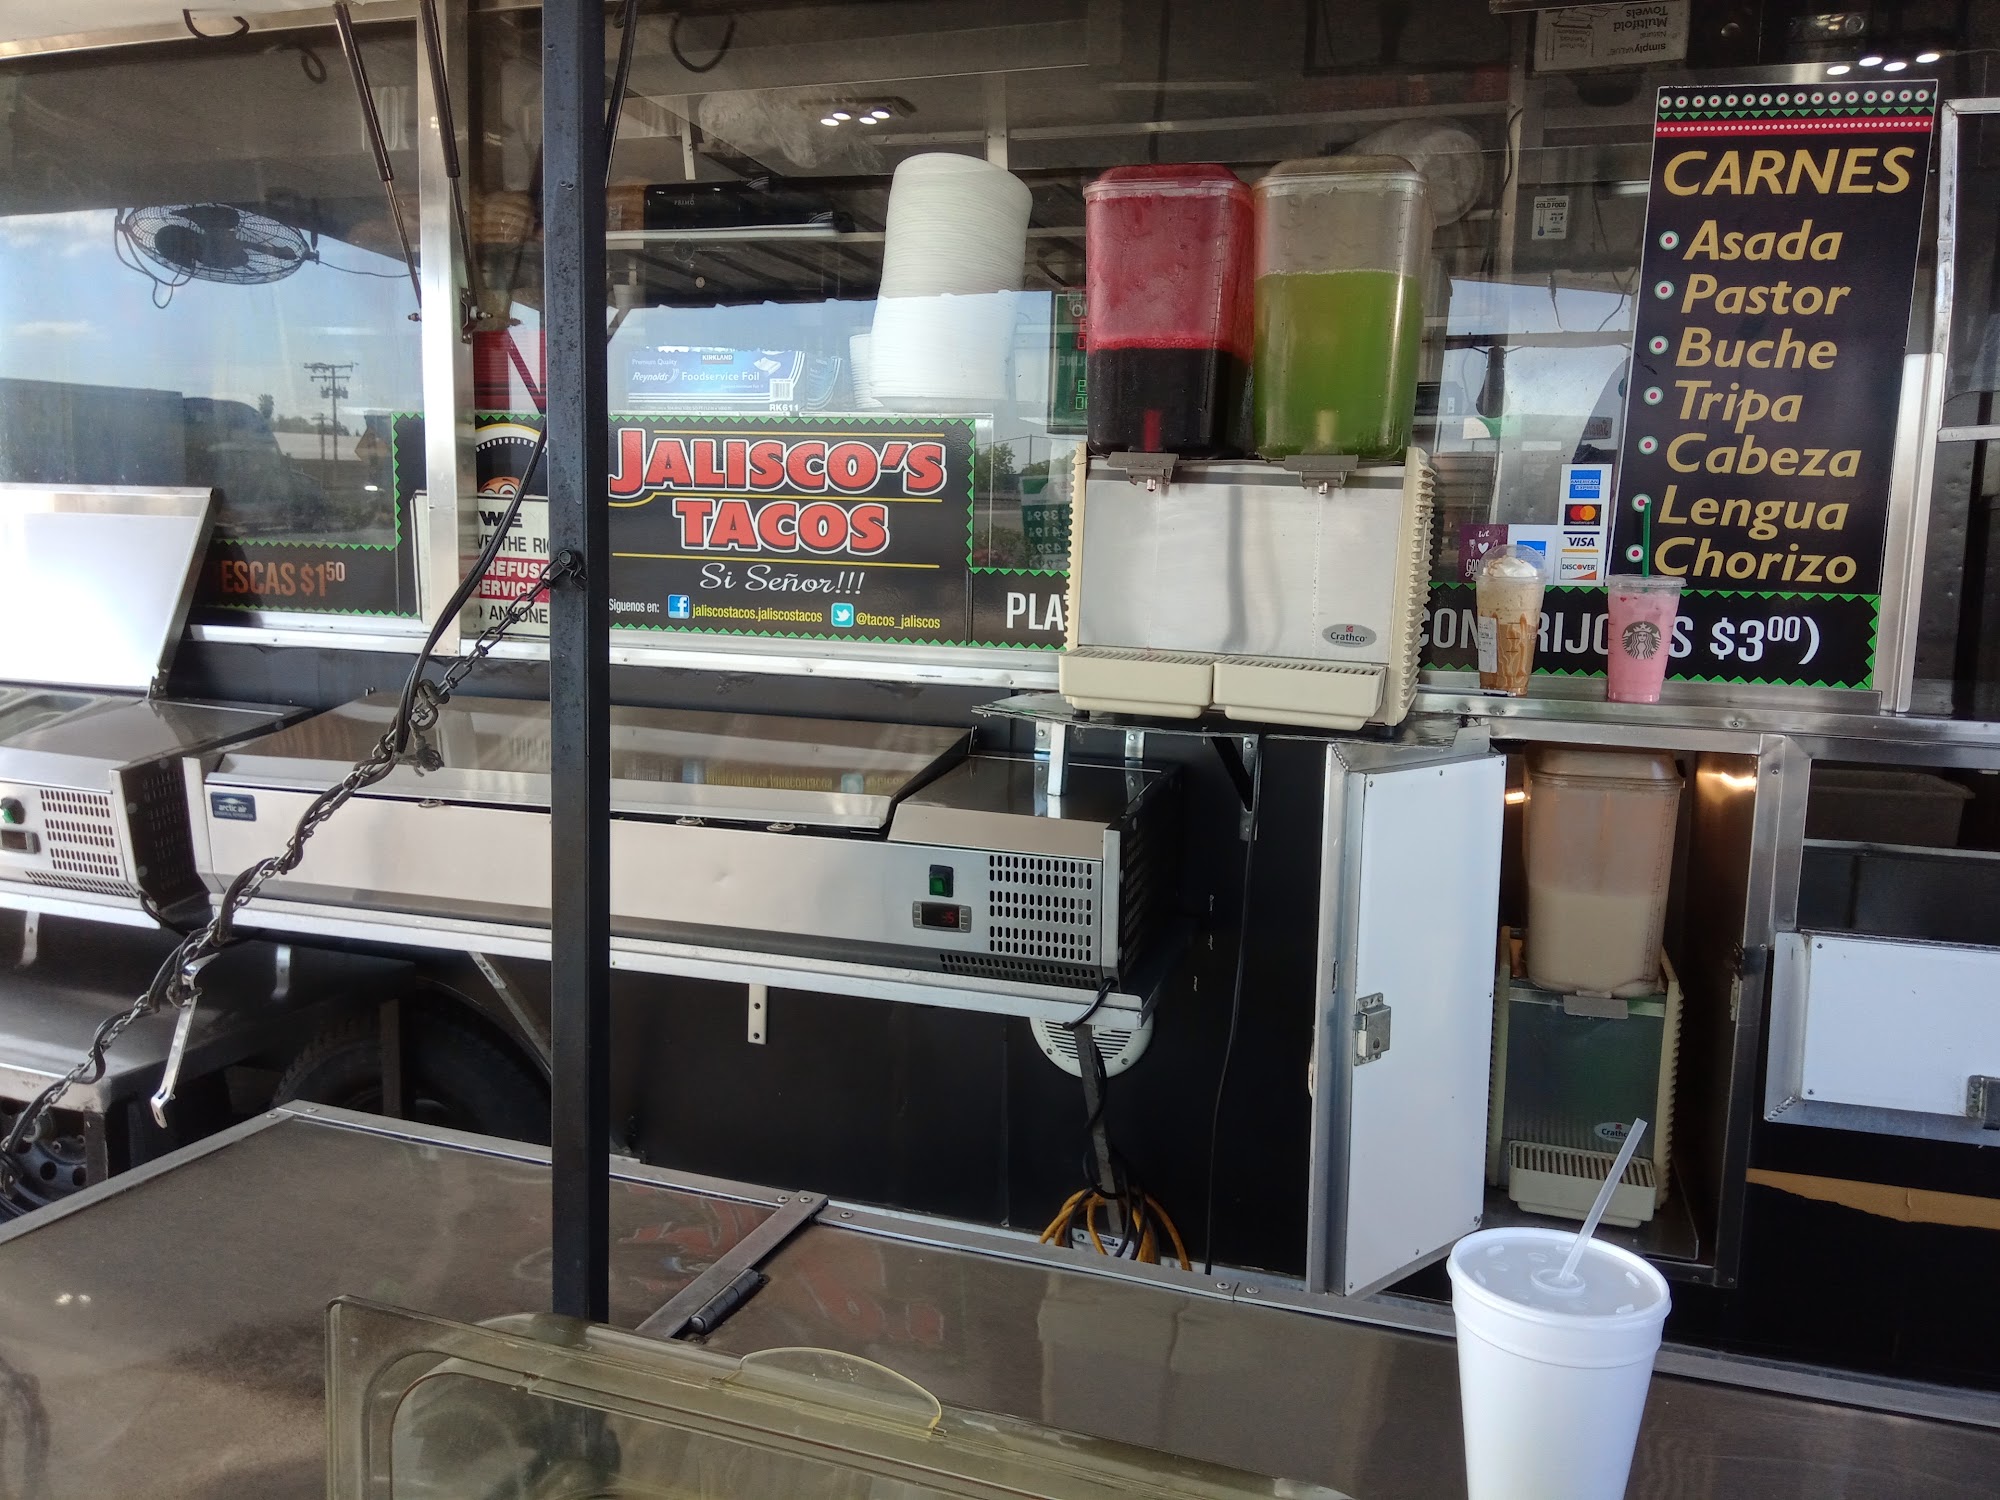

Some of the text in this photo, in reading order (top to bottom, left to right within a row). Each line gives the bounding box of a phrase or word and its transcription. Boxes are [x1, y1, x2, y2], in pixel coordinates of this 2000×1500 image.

[1626, 5, 1668, 17] Towels
[1613, 17, 1668, 33] Multifold
[1663, 146, 1915, 196] CARNES
[1682, 219, 1843, 261] Asada
[1681, 273, 1851, 315] Pastor
[1675, 326, 1838, 370] Buche
[657, 358, 677, 367] Quality
[632, 371, 760, 382] Reynolds Foodservice Foil
[769, 403, 799, 412] RK611
[1674, 380, 1804, 434] Tripa
[608, 428, 947, 498] JALISCO'S
[1666, 432, 1862, 478] Cabeza
[479, 511, 523, 528] WE
[1658, 484, 1850, 541] Lengua
[672, 498, 890, 555] TACOS
[1567, 537, 1596, 547] VISA
[1561, 563, 1596, 571] DISCOVER
[1654, 536, 1857, 584] Chorizo
[700, 562, 866, 595] Si Señor!!!
[646, 602, 660, 614] en:
[692, 602, 823, 623] jaliscostacos.jaliscostacos
[856, 611, 941, 630] @tacos_jaliscos
[1330, 631, 1368, 643] Crathco
[1601, 1128, 1629, 1138] Crathc
